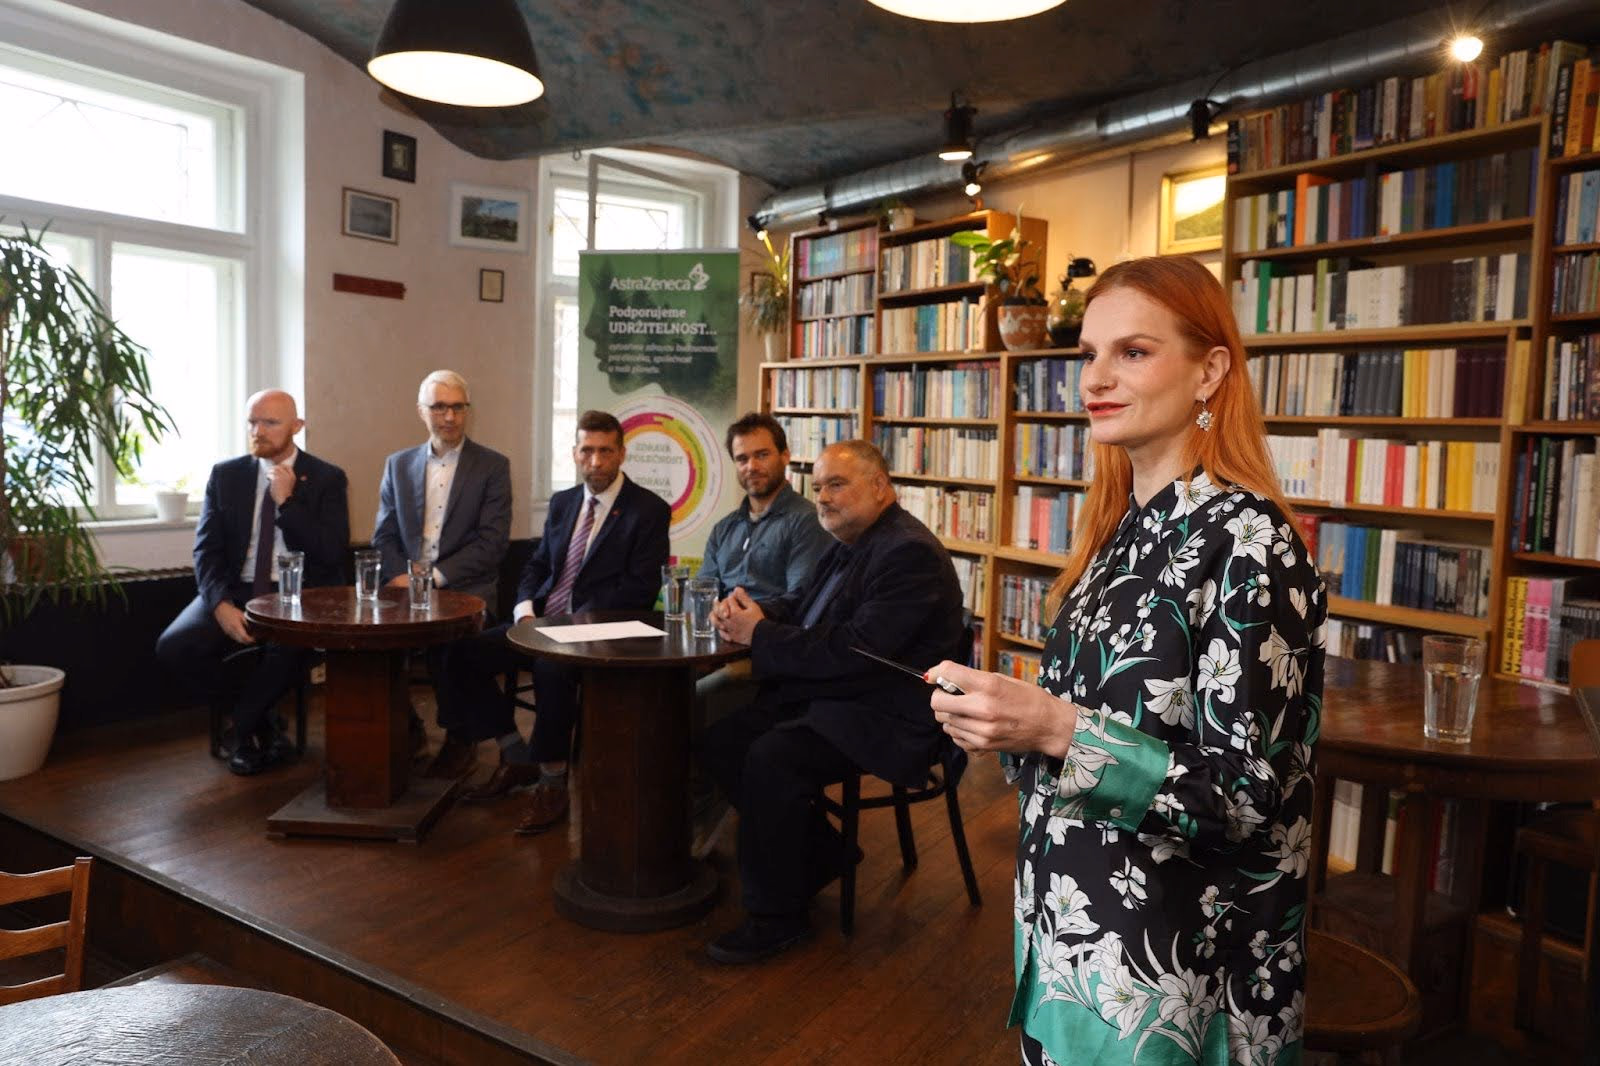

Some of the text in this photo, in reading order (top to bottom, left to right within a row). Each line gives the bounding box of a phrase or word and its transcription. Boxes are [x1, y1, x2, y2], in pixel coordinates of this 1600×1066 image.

[610, 277, 691, 291] AstraZeneca
[609, 306, 687, 319] Podporujeme
[608, 321, 717, 335] UDRŽITELNOST...
